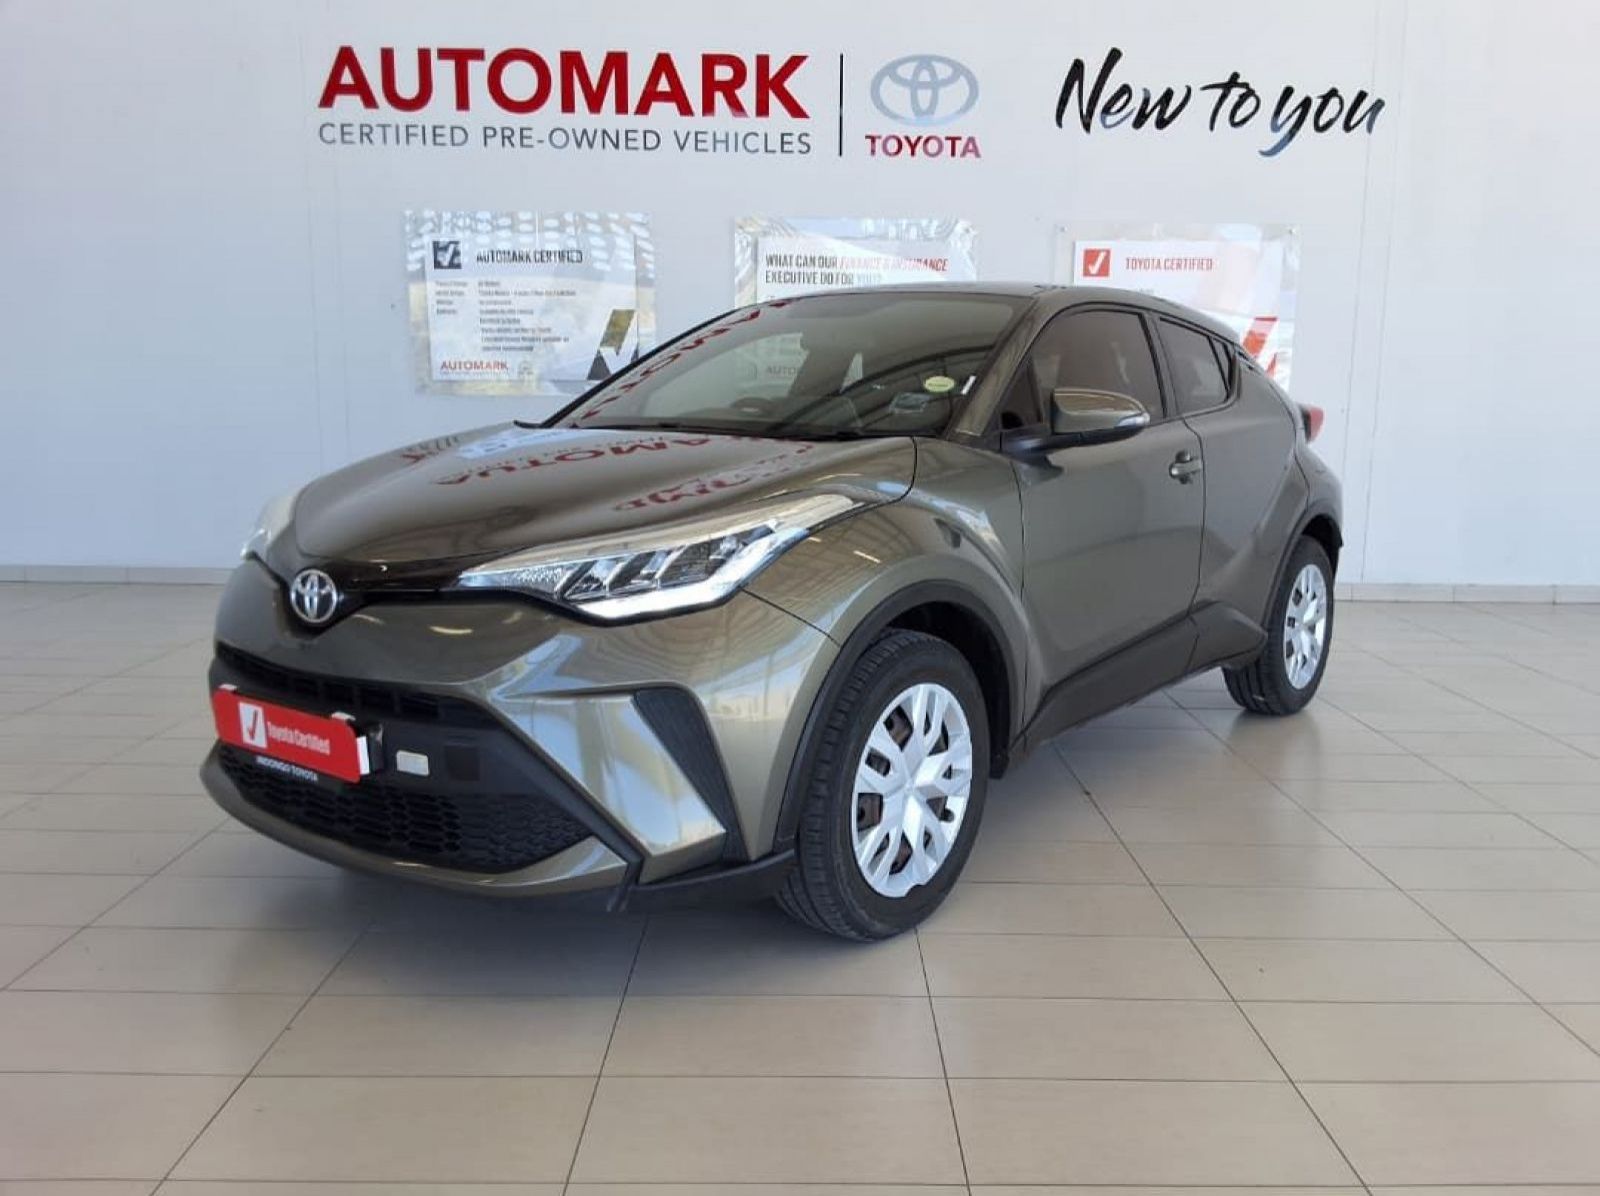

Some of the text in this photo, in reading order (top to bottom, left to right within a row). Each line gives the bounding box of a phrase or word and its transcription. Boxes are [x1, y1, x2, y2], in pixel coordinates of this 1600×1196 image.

[318, 45, 811, 119] AUTOMARK
[1055, 47, 1386, 157] New to you
[318, 122, 812, 154] CERTIFIED PRE-OWNED VEHICLES
[865, 134, 982, 159] TOYOTA
[476, 250, 583, 263] AUTOMARK CERTIFIED
[765, 254, 793, 268] WHAT
[795, 254, 816, 268] CAN
[817, 255, 838, 268] OUR
[1125, 257, 1214, 271] TOYOTA CERTIFIED
[765, 270, 818, 284] EXECUTIVE
[820, 271, 834, 285] DO
[440, 360, 508, 371] AUTOMARK
[267, 721, 331, 755] Toyota Certified
